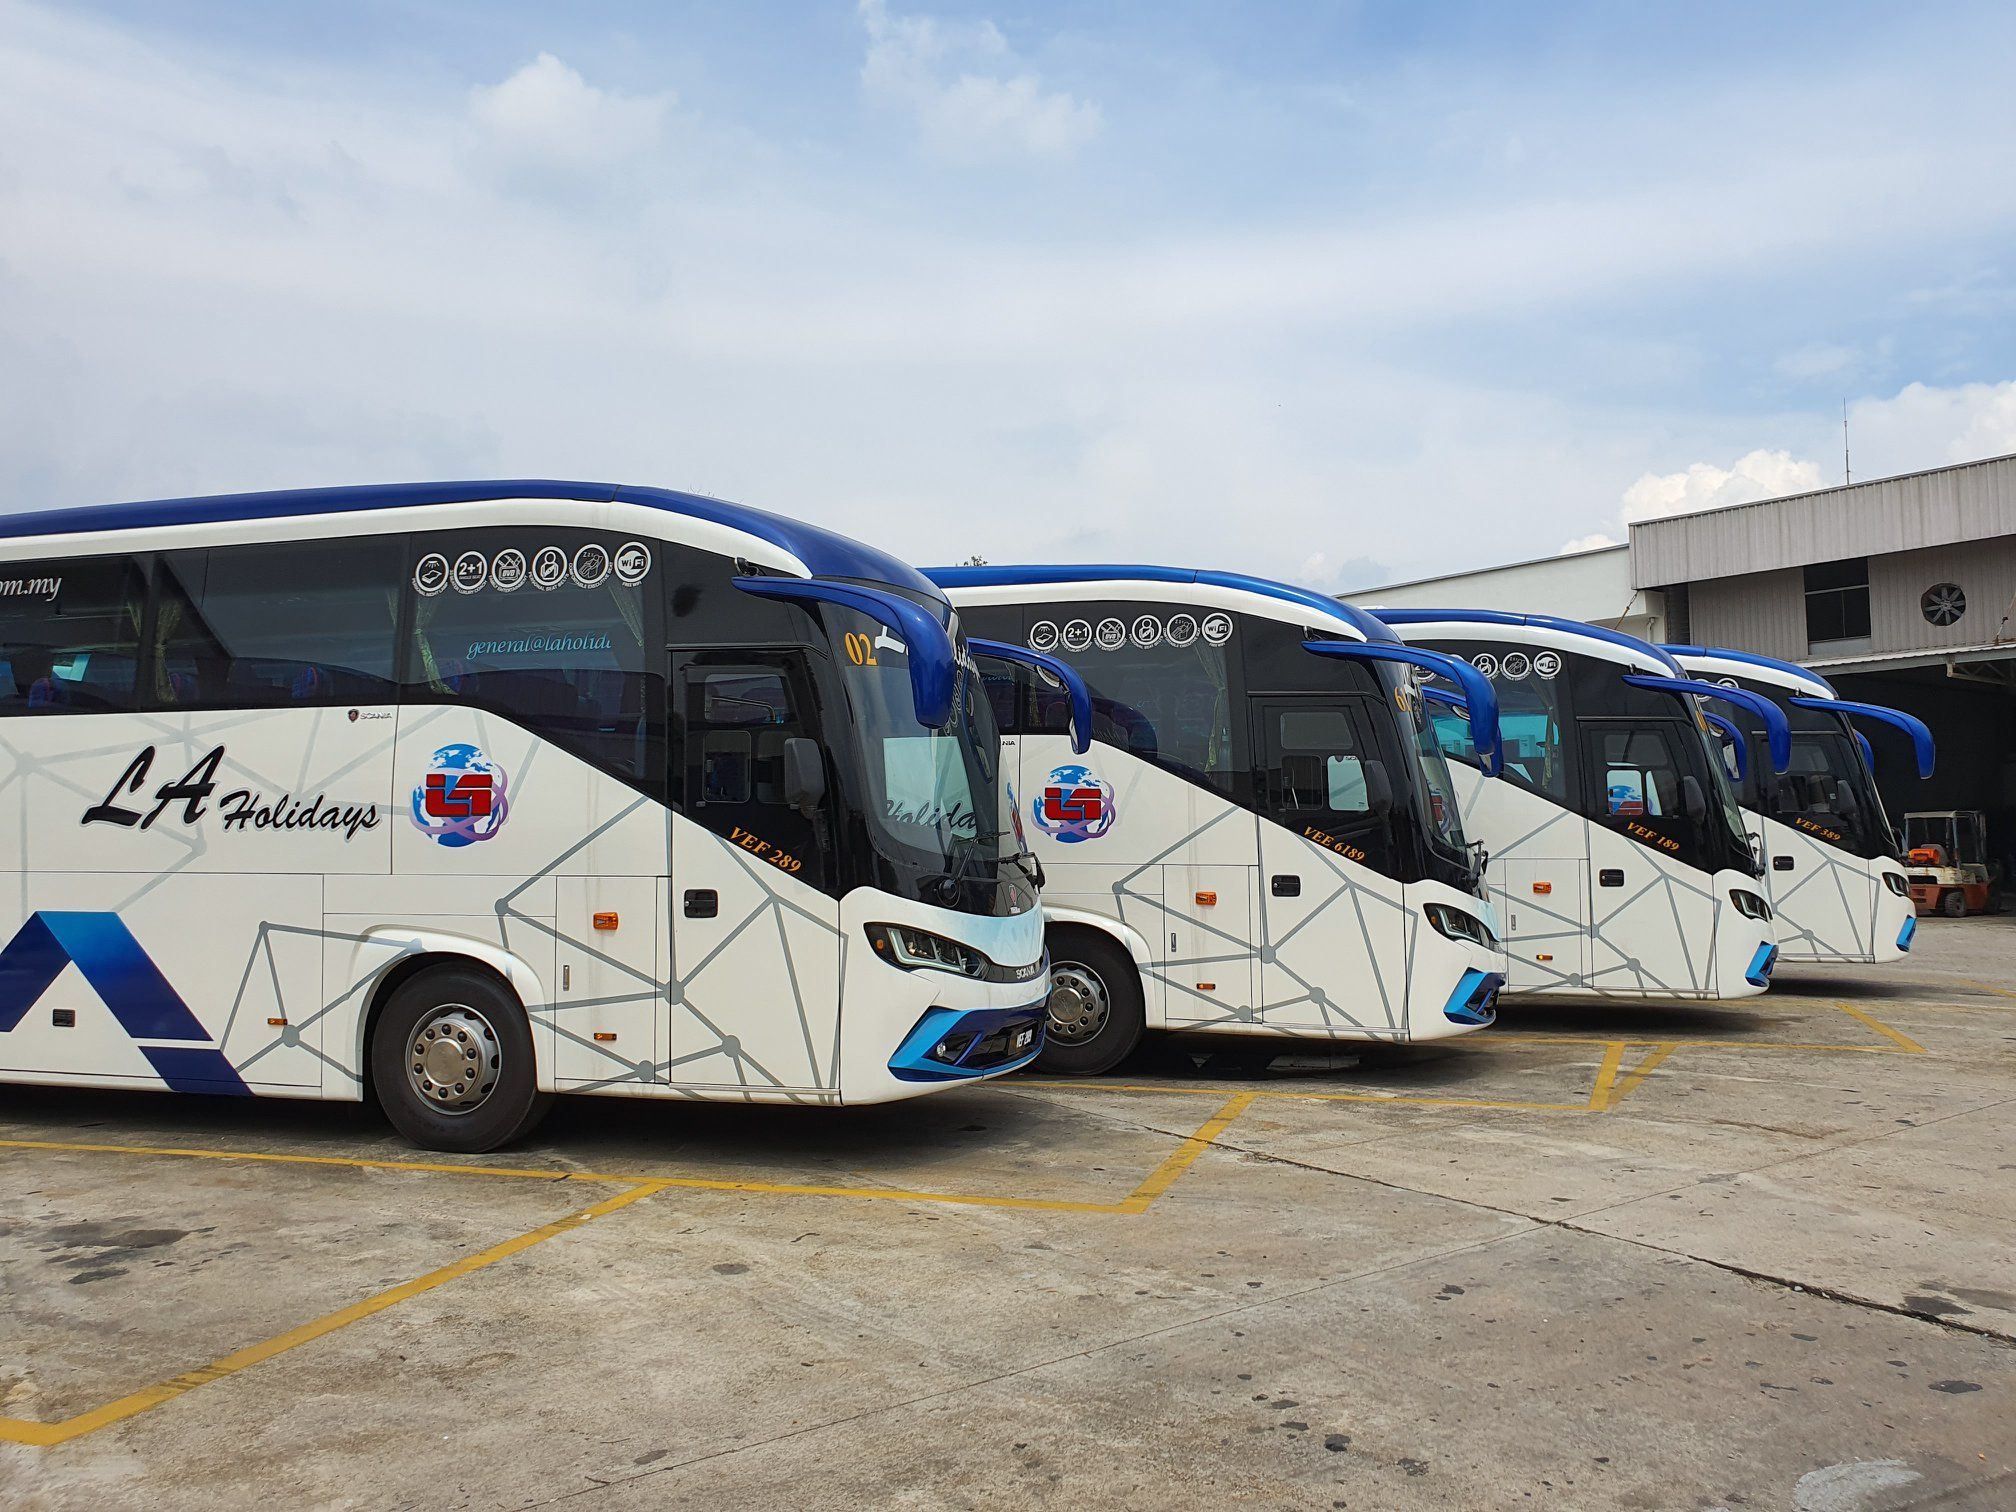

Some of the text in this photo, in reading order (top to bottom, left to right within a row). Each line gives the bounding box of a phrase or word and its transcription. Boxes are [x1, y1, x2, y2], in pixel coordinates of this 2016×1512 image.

[459, 561, 483, 576] 2+1
[1068, 627, 1088, 638] 2+1
[845, 632, 878, 666] 02
[81, 745, 380, 840] LA Holidays
[1304, 826, 1365, 860] VEE 6189
[1627, 822, 1680, 850] VEF 189
[1796, 817, 1841, 840] VEF 389
[730, 826, 802, 872] VEF 289
